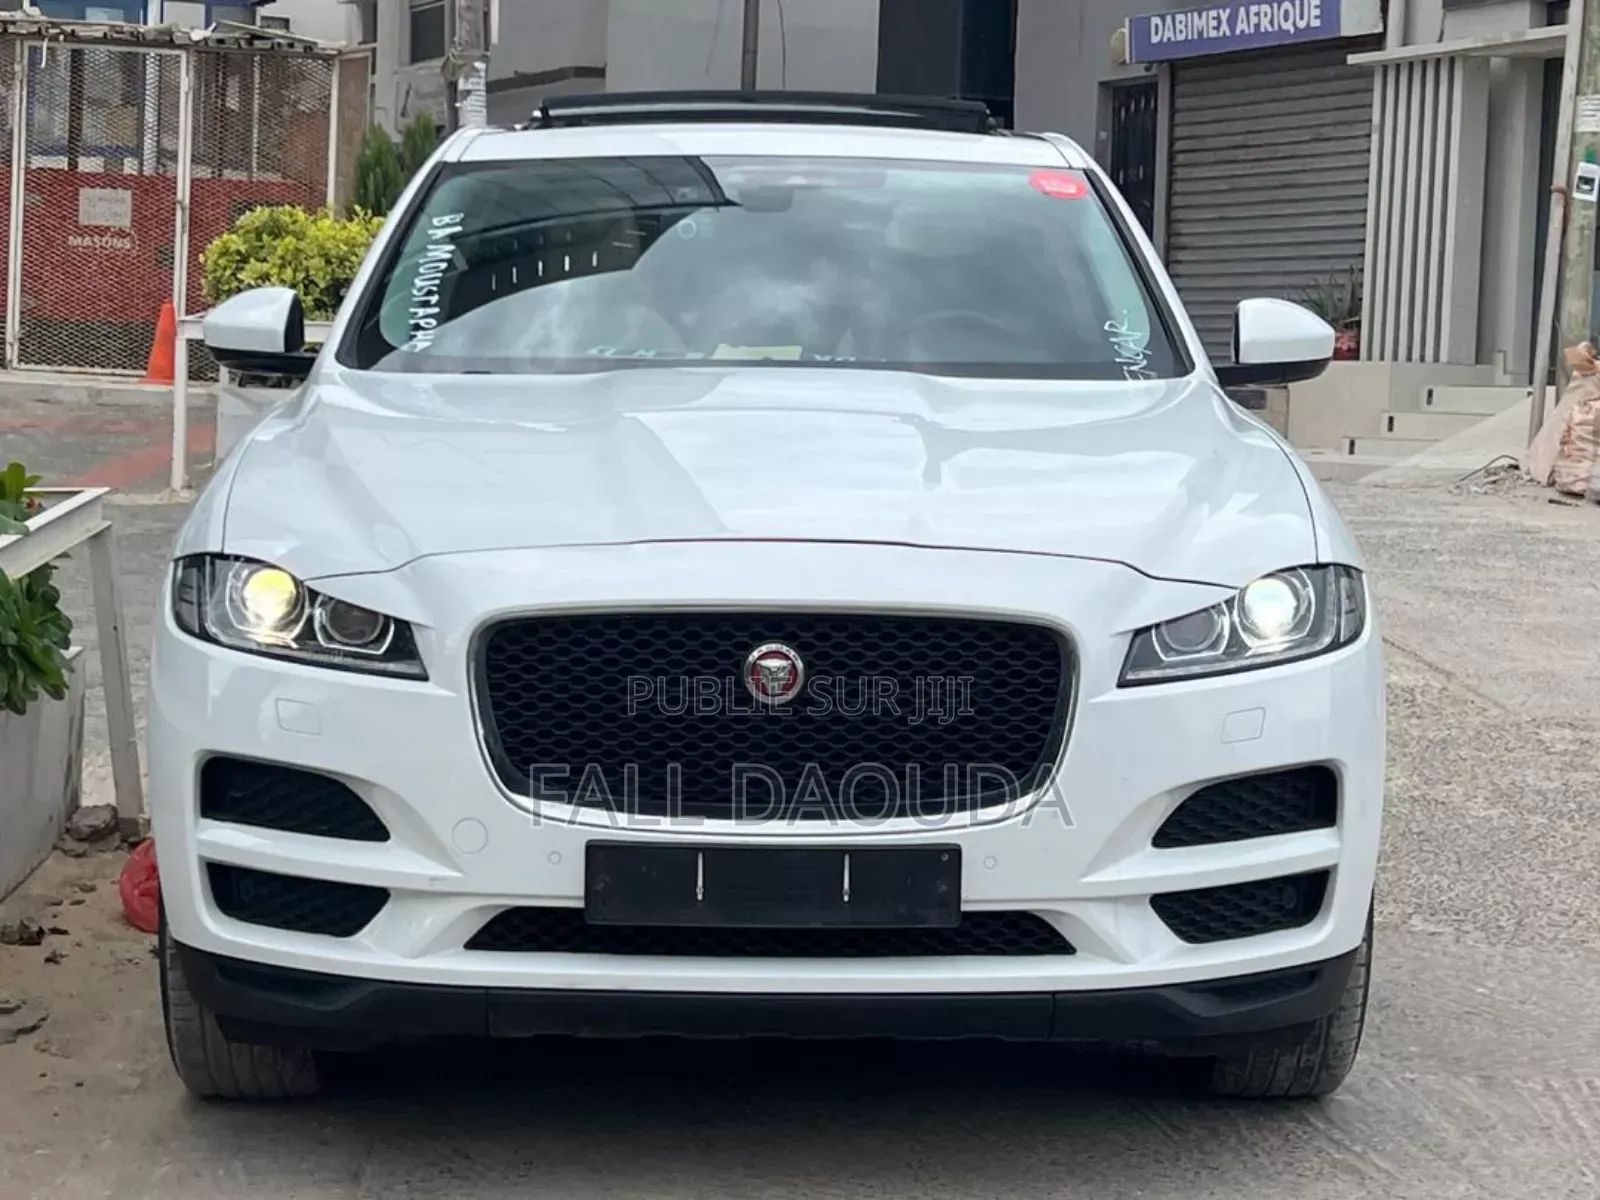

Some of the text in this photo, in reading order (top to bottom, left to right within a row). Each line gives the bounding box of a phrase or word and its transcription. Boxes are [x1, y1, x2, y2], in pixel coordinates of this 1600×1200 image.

[1150, 0, 1321, 44] DABIMEX AFRIQUE
[401, 212, 465, 353] BA MOUSTAPHA
